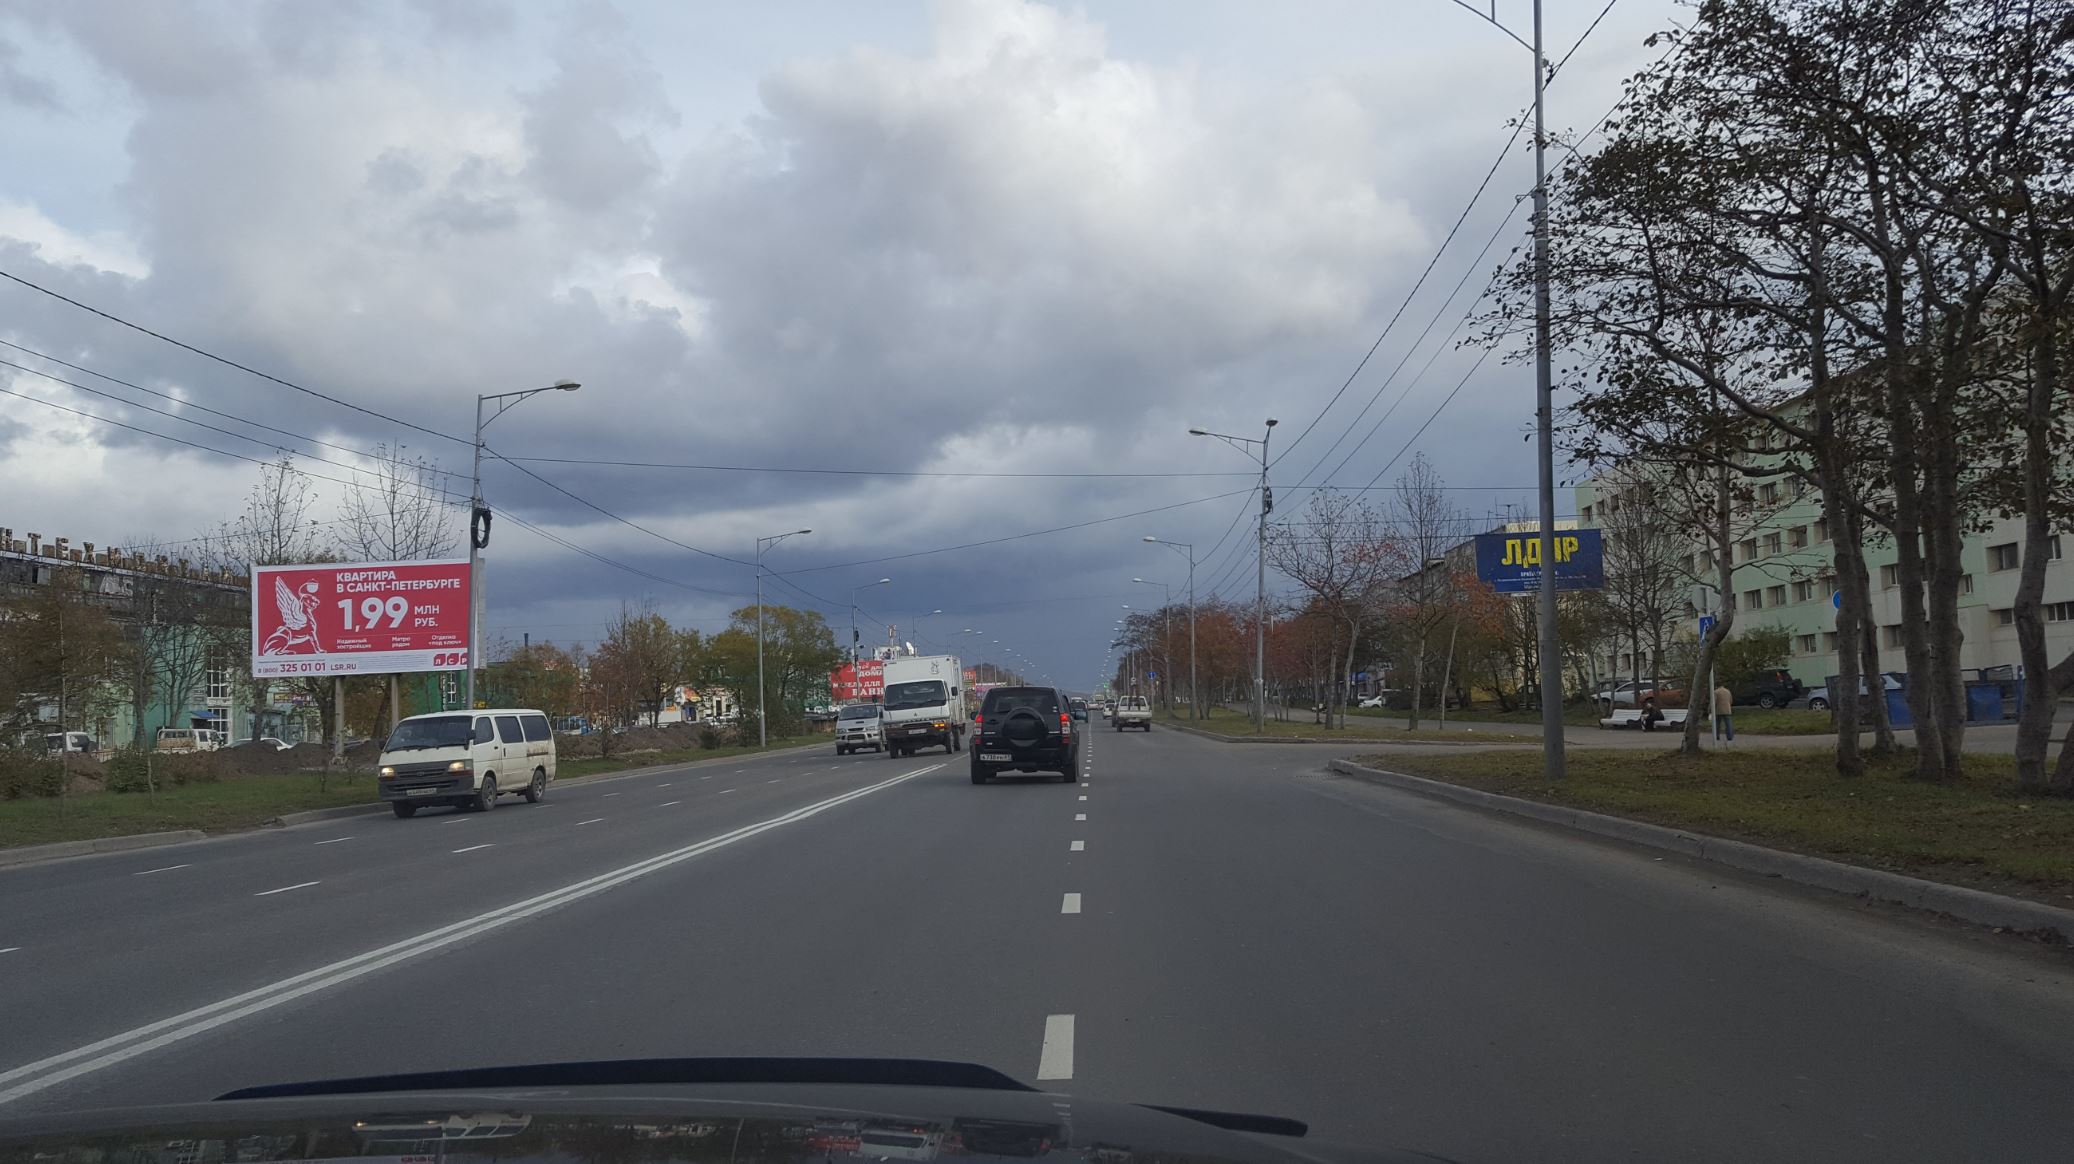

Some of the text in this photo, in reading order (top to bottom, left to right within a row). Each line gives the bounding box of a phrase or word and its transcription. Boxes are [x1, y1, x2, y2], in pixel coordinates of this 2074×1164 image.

[336, 570, 396, 582] КВАРТИРА
[336, 579, 460, 593] В САНКТ-ПЕТЕРБУРГЕ
[337, 596, 409, 632] 1,99
[414, 605, 440, 615] МЛН
[414, 617, 439, 627] РУБ.
[280, 663, 298, 673] 325
[300, 663, 312, 672] 01
[314, 662, 326, 672] 01
[330, 663, 357, 671] LSR.RU
